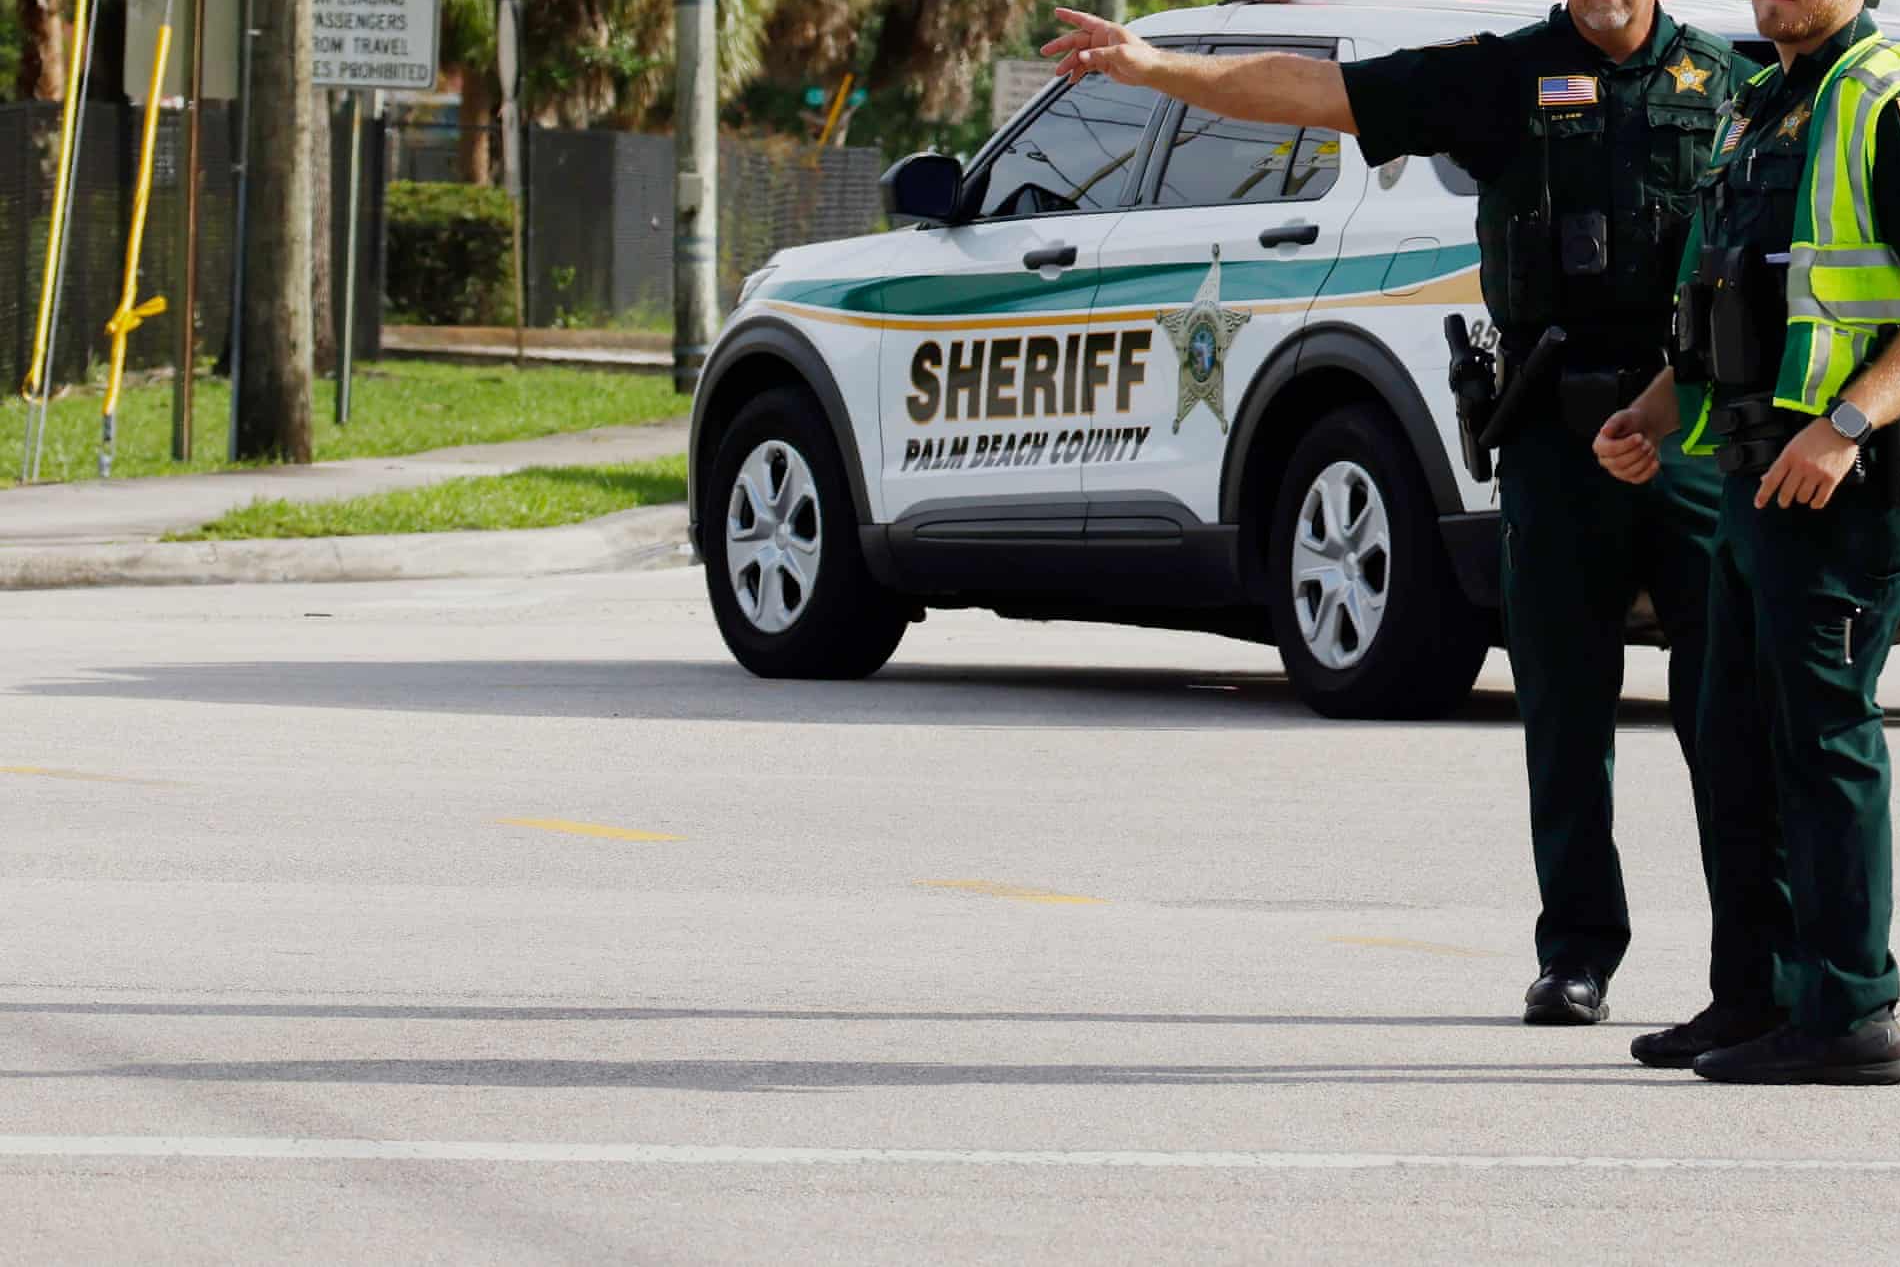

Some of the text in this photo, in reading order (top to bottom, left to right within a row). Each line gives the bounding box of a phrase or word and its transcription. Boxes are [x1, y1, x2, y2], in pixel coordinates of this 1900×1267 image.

[313, 11, 408, 30] ASSENGERS
[312, 36, 409, 55] ROM TRAVEL
[339, 61, 429, 81] PROHIBITED
[905, 329, 1153, 426] SHERIFF
[900, 426, 1152, 472] PALM BEACH COUNTY
